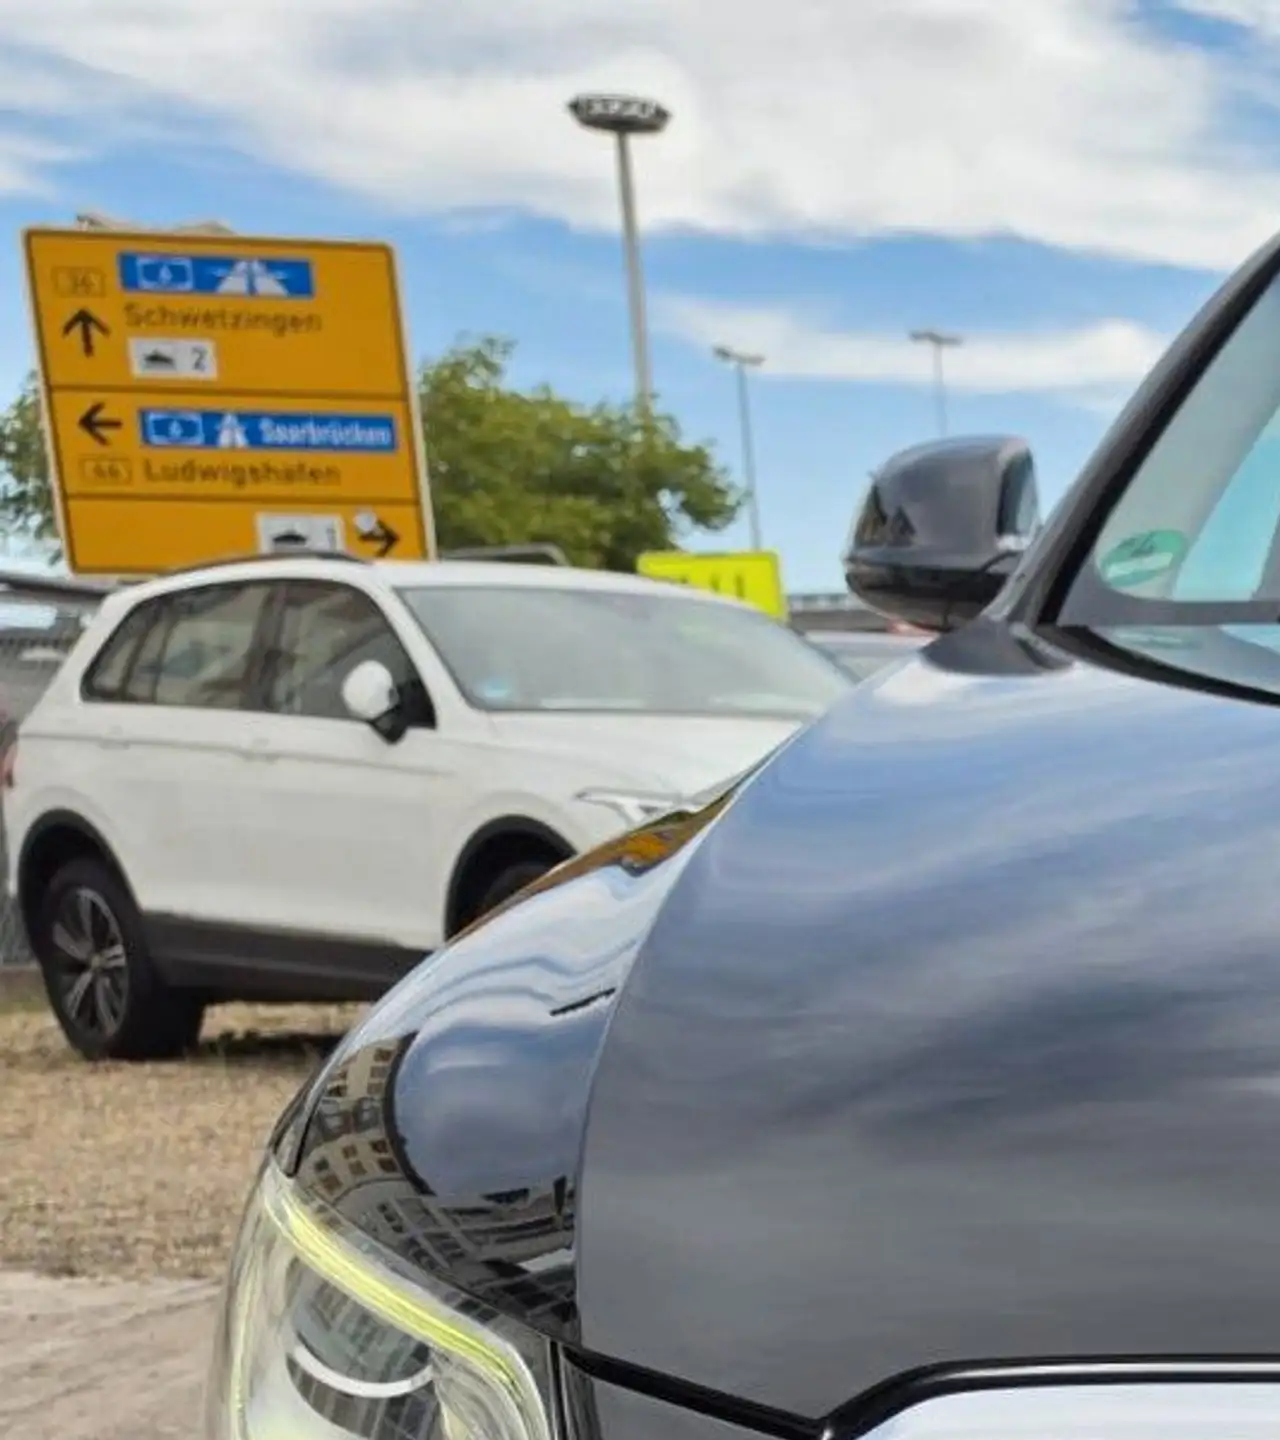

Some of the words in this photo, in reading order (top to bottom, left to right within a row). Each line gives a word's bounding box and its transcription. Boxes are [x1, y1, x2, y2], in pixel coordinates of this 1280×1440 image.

[124, 302, 322, 338] Schwetzingen
[191, 346, 209, 373] 2
[259, 415, 392, 447] Saarbrücken
[144, 456, 341, 488] Ludwigshafen
